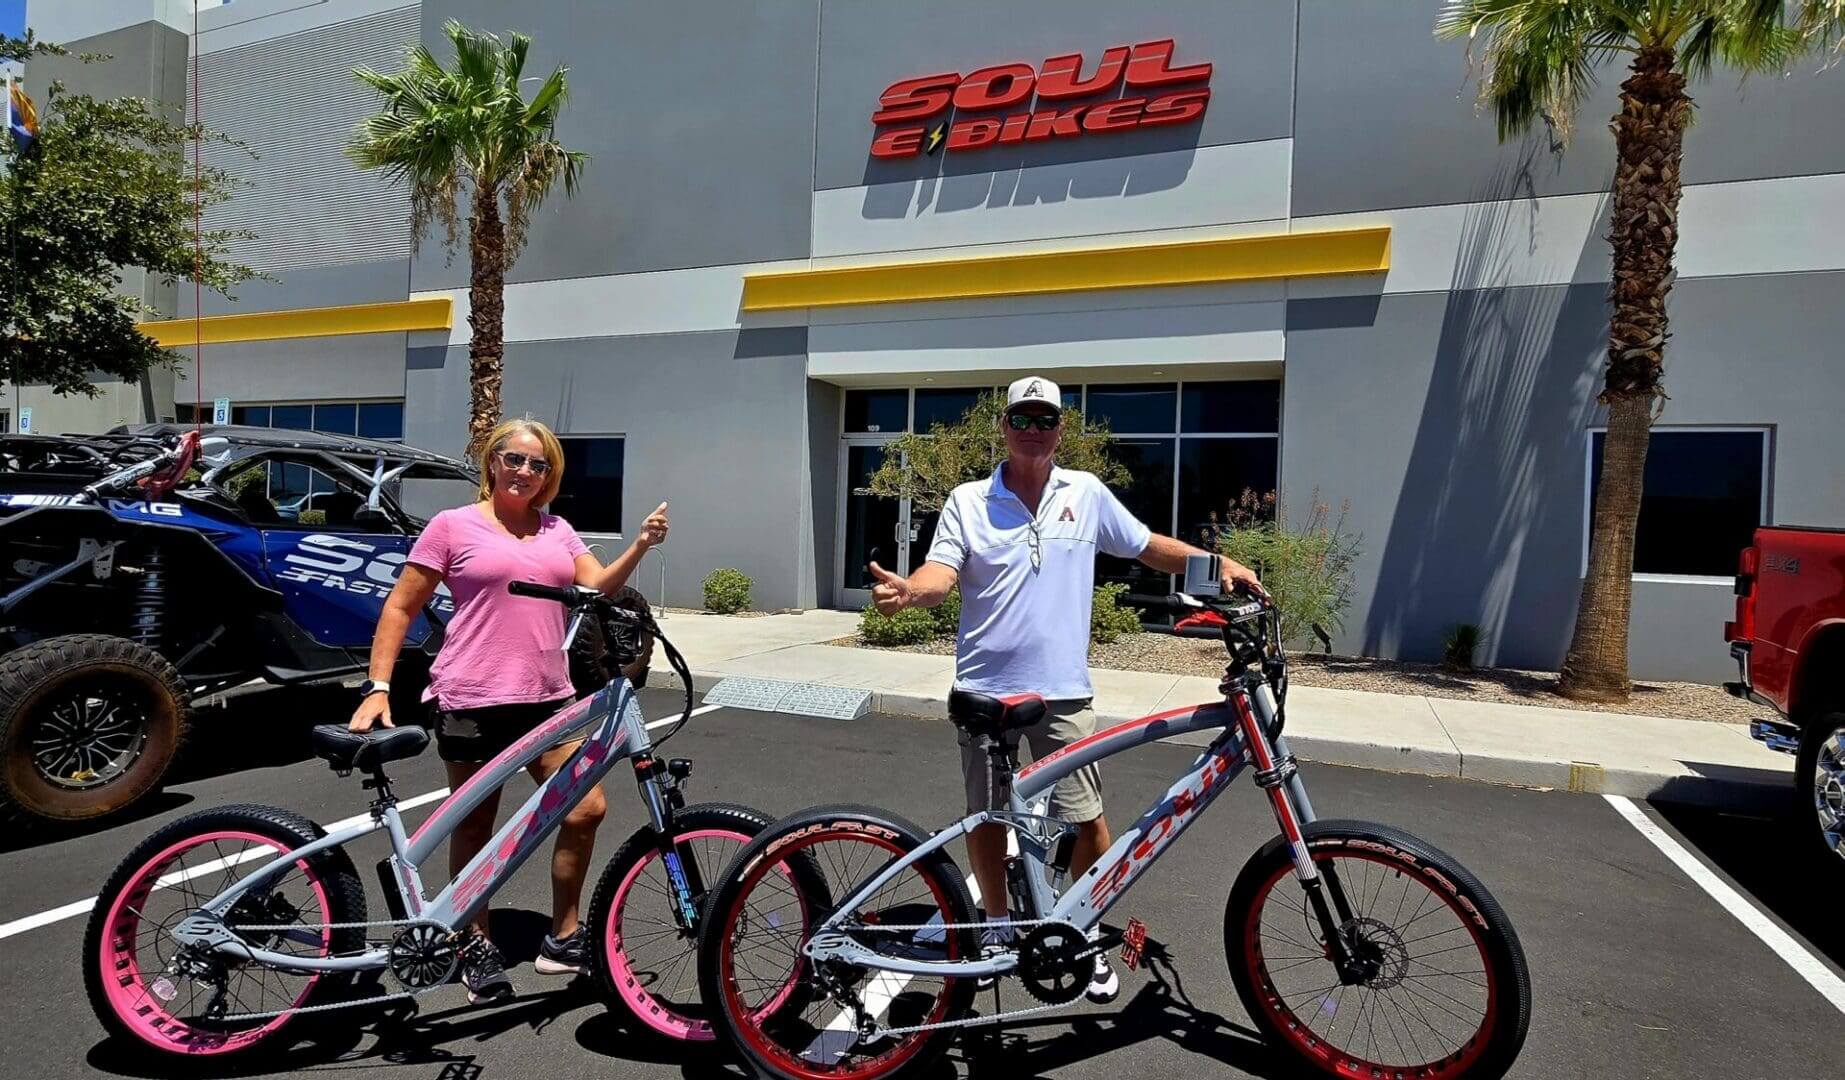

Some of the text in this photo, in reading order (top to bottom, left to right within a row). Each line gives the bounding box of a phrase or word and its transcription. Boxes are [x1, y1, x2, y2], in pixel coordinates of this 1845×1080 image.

[871, 39, 1212, 125] SOUL
[870, 87, 1212, 158] E BIKES
[1058, 506, 1075, 522] A
[831, 821, 900, 840] FAST
